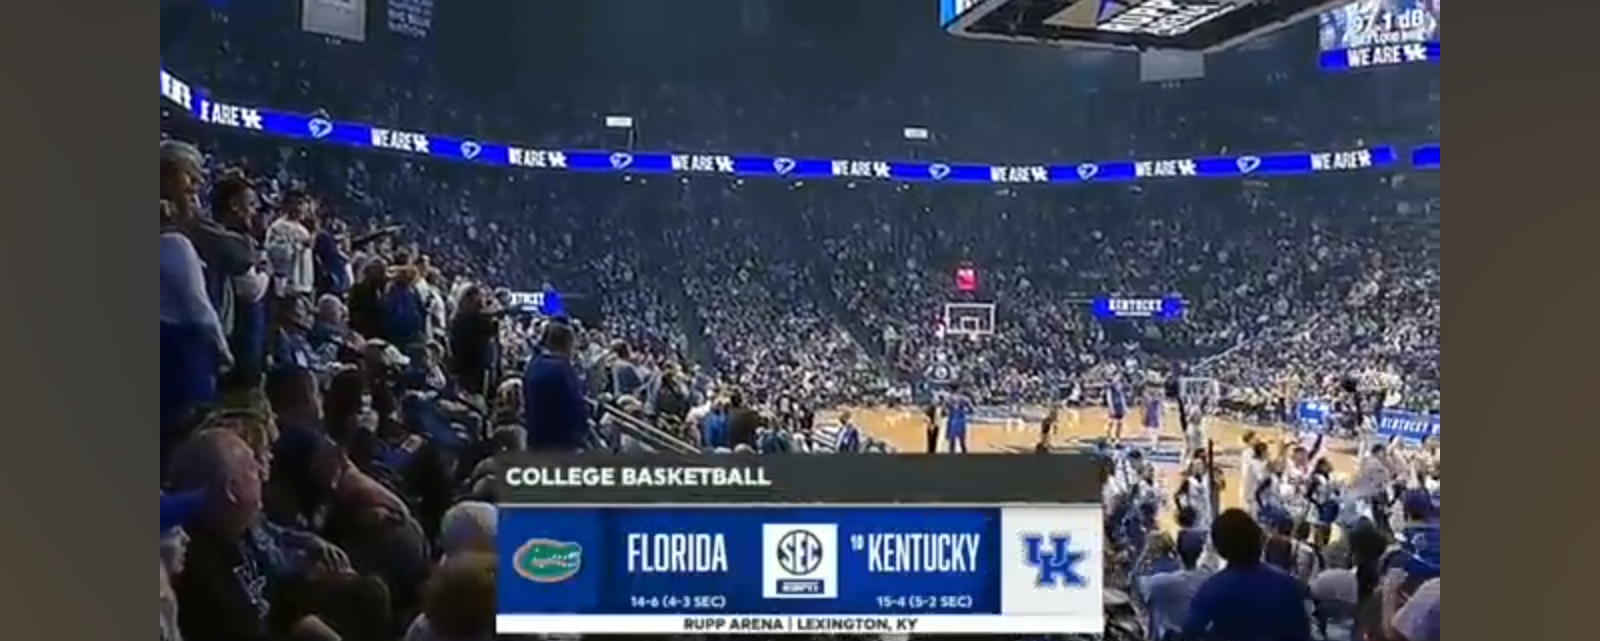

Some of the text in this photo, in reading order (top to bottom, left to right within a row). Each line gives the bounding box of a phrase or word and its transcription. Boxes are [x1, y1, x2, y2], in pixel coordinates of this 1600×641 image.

[1347, 48, 1371, 67] WE
[1372, 45, 1401, 65] ARE
[212, 103, 240, 127] ARE
[371, 128, 388, 147] WE
[389, 131, 413, 151] ARE
[508, 147, 523, 165] WE
[524, 149, 547, 168] ARE
[672, 155, 690, 171] WE
[691, 155, 715, 172] ARE
[1311, 153, 1332, 170] WE
[1333, 151, 1357, 169] ARE
[832, 160, 849, 176] WE
[850, 161, 872, 177] ARE
[991, 166, 1008, 182] WE
[1009, 166, 1031, 183] ARE
[1135, 161, 1153, 177] WE
[1154, 160, 1177, 176] ARE
